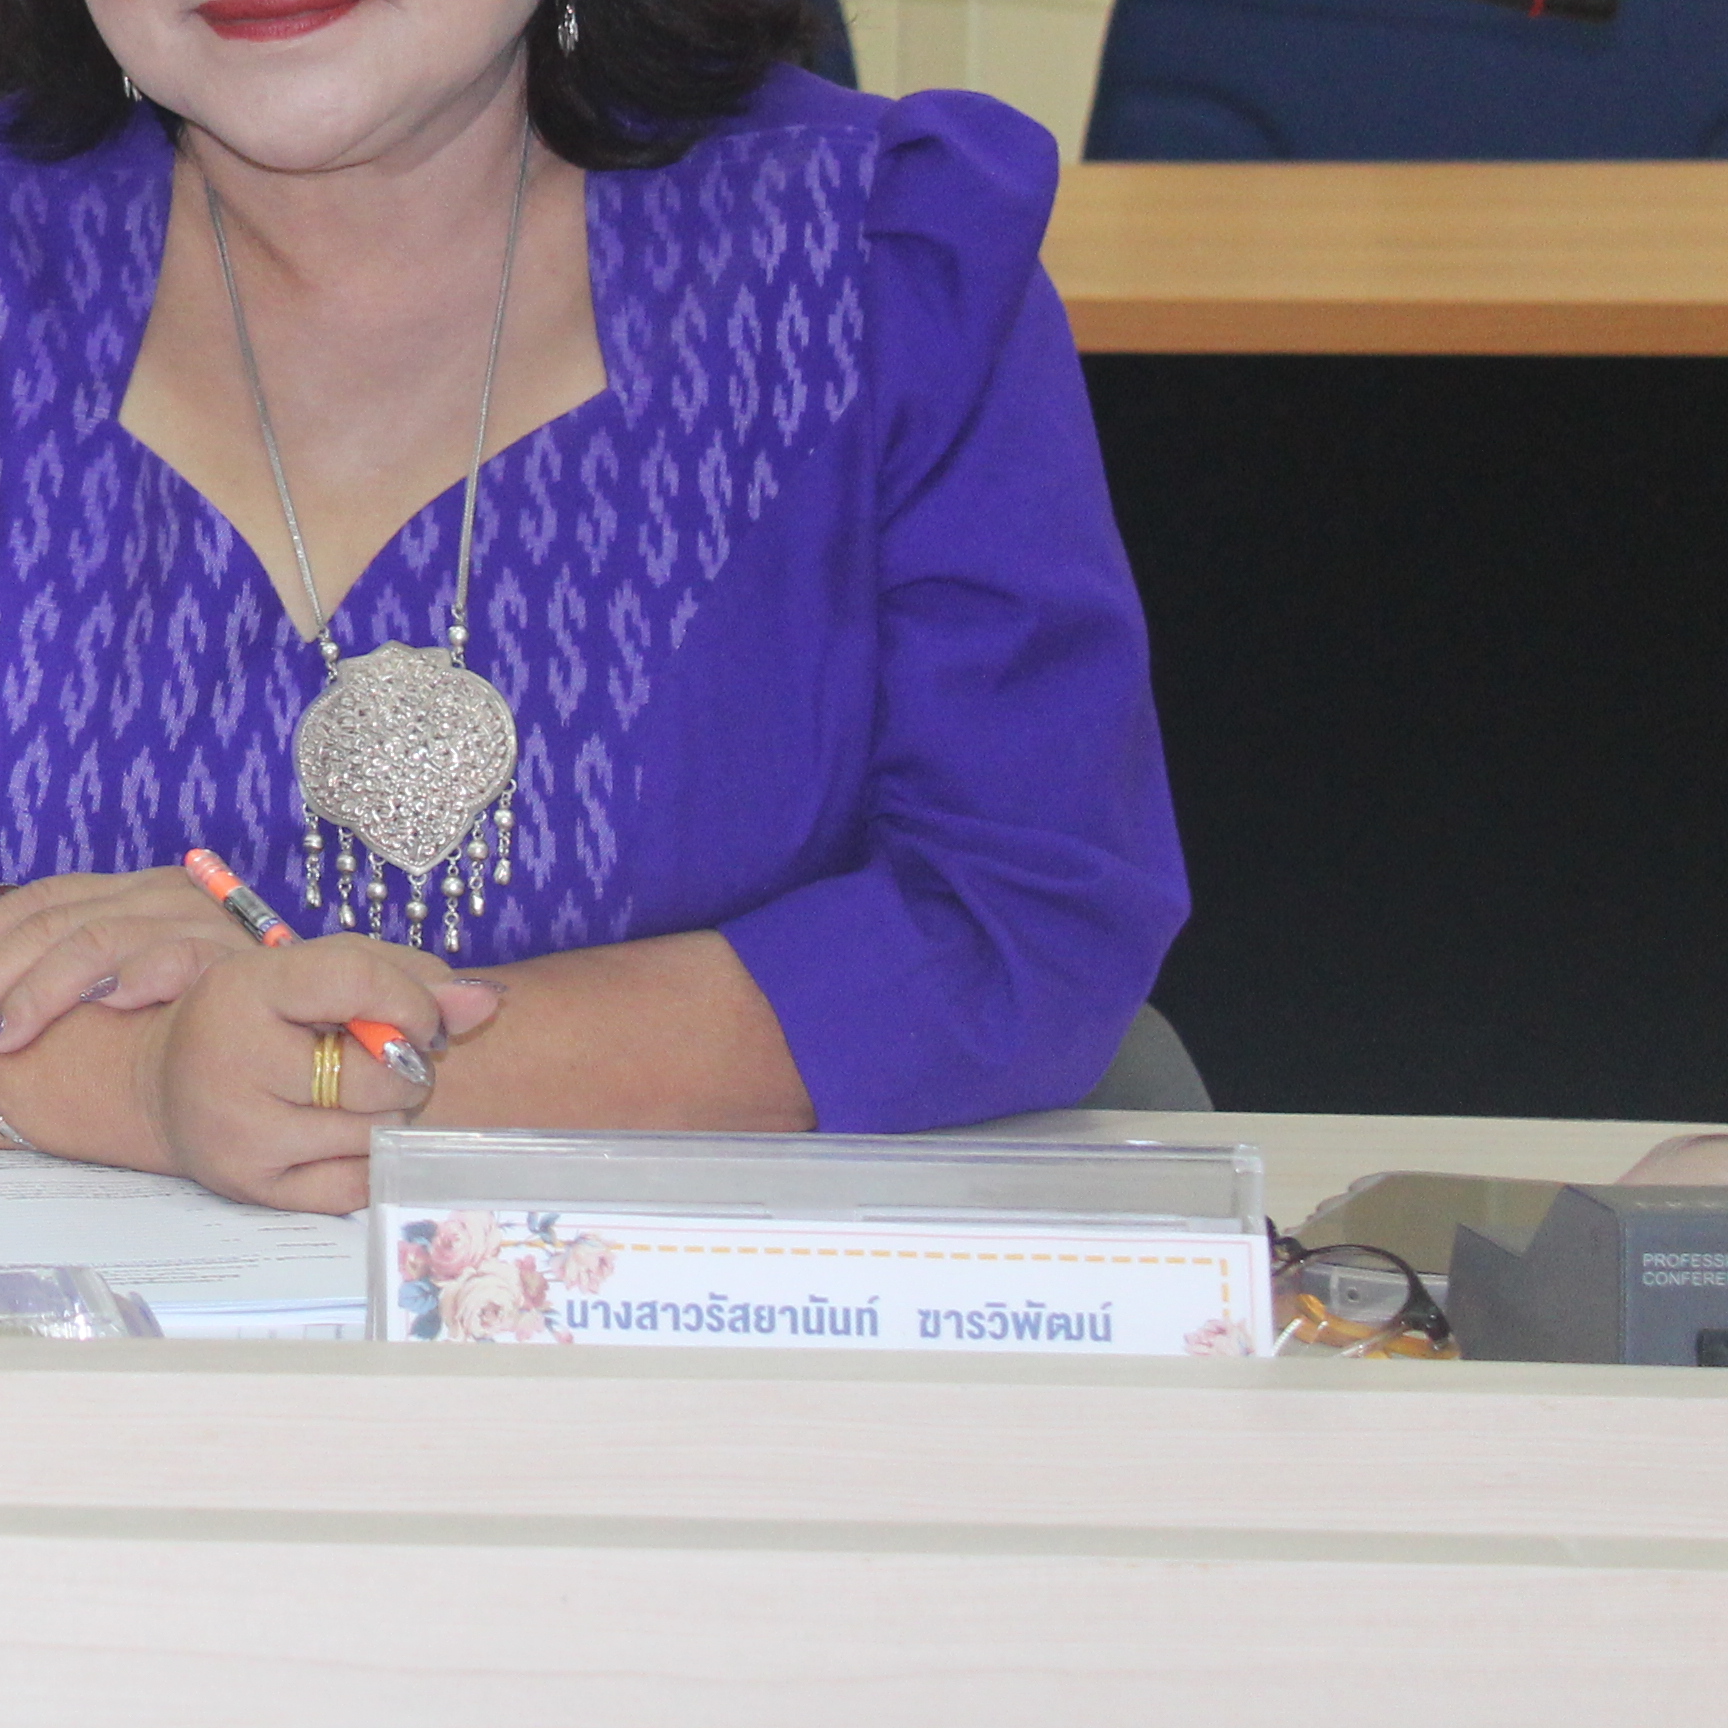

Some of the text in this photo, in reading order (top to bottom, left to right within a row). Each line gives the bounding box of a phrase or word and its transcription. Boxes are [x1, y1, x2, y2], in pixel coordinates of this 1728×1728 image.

[1642, 1271, 1728, 1287] CONFERE
[565, 1291, 880, 1337] นางสาวรัสยานันท์
